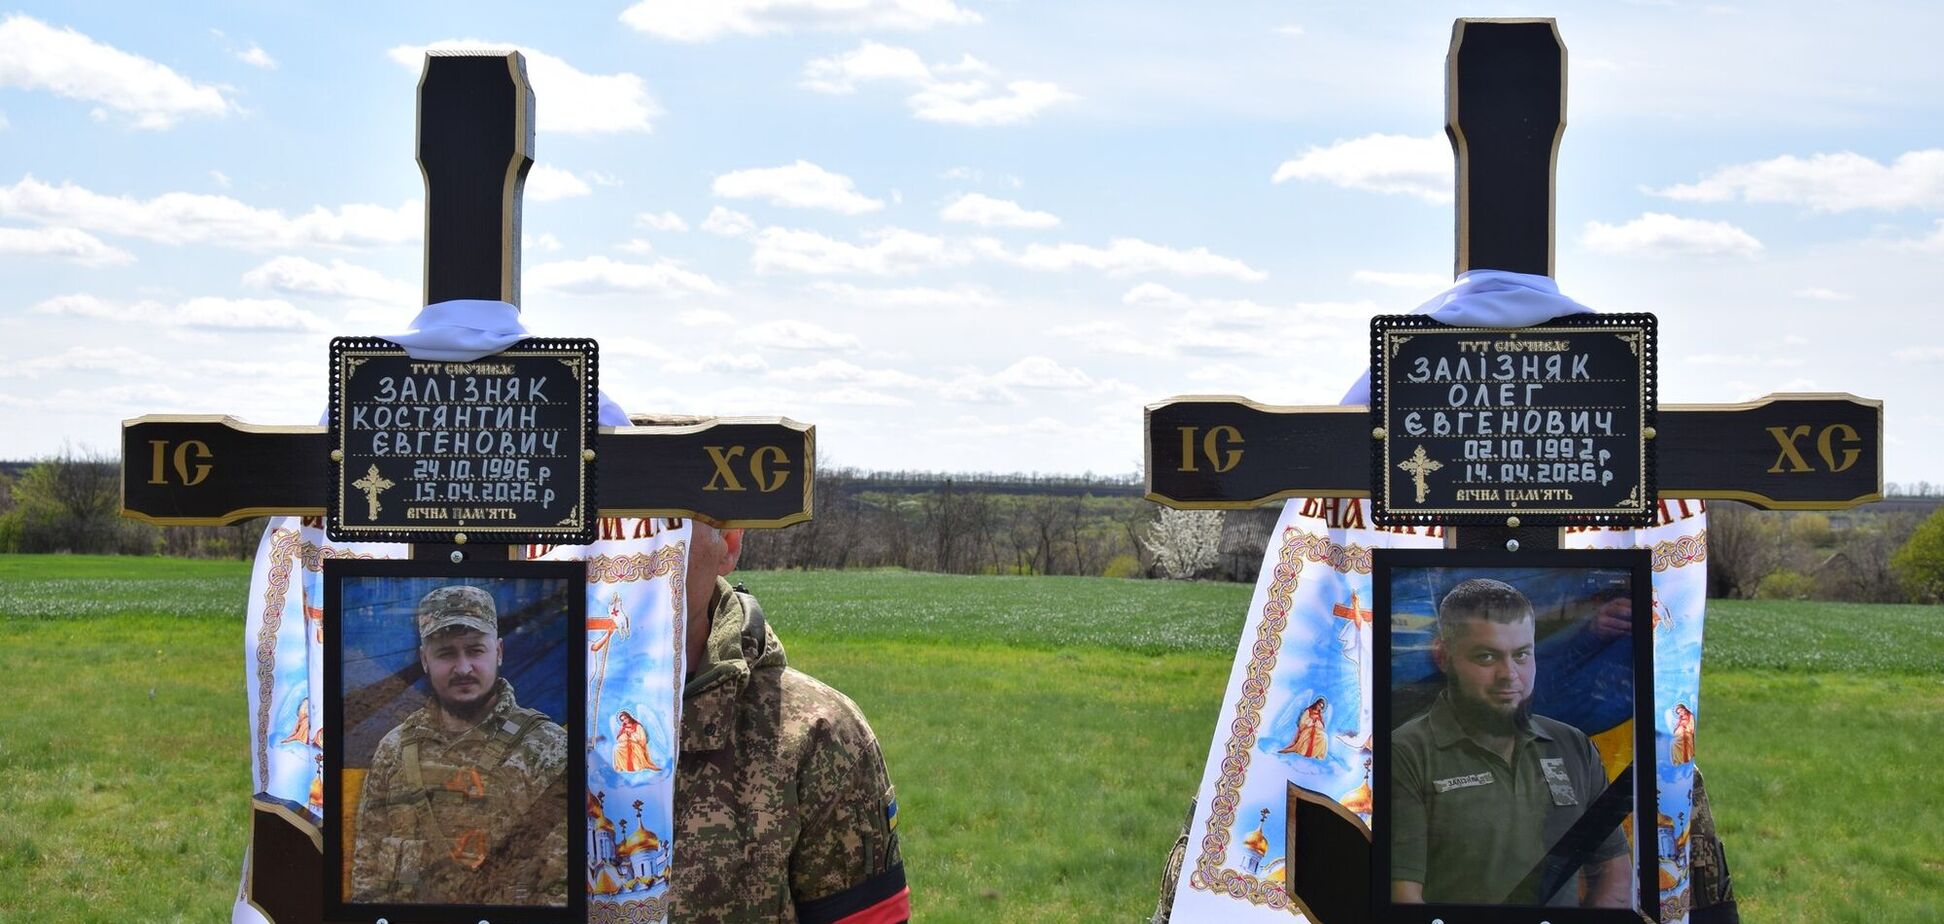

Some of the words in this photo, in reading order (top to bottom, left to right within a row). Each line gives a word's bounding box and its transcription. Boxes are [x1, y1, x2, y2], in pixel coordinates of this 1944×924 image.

[1458, 341, 1491, 353] ТУТ
[410, 363, 442, 375] ТУТ
[1407, 351, 1590, 382] ЗАЛІЗНЯК
[373, 374, 549, 403] ЗАЛІЗНЯК
[1448, 383, 1543, 408] ОЛЕГ
[352, 405, 537, 431] КОСТЯНТИН
[1404, 410, 1613, 436] ЄВГЕНОВИЧ
[372, 430, 559, 456] ЄВГЕНОВИЧ
[1456, 488, 1500, 501] ВІЧНА
[1505, 488, 1573, 501] ПАМ'ЯТЬ
[407, 507, 448, 520] ВІЧНА
[452, 507, 517, 520] ПАМ'ЯТЬ
